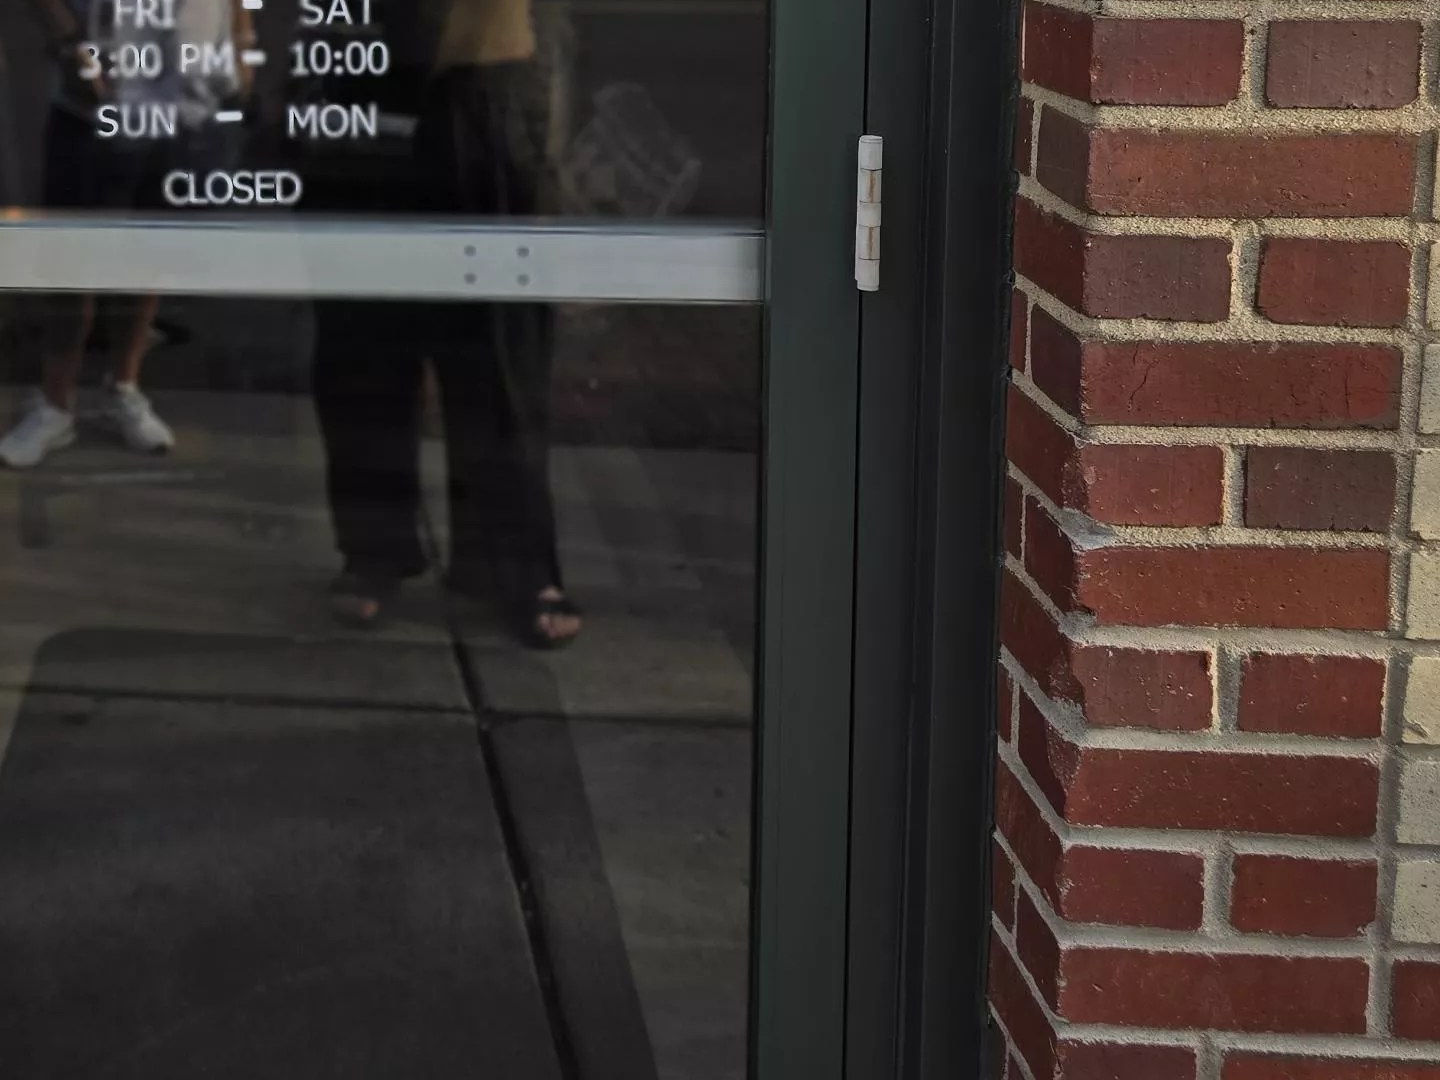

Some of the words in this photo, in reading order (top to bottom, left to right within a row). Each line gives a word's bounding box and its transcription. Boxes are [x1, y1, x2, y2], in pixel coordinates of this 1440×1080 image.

[78, 40, 162, 80] 3:00
[179, 41, 235, 77] PM
[289, 39, 391, 77] 10:00
[96, 103, 179, 139] SUN
[287, 102, 378, 139] MON
[163, 170, 303, 206] CLOSED
